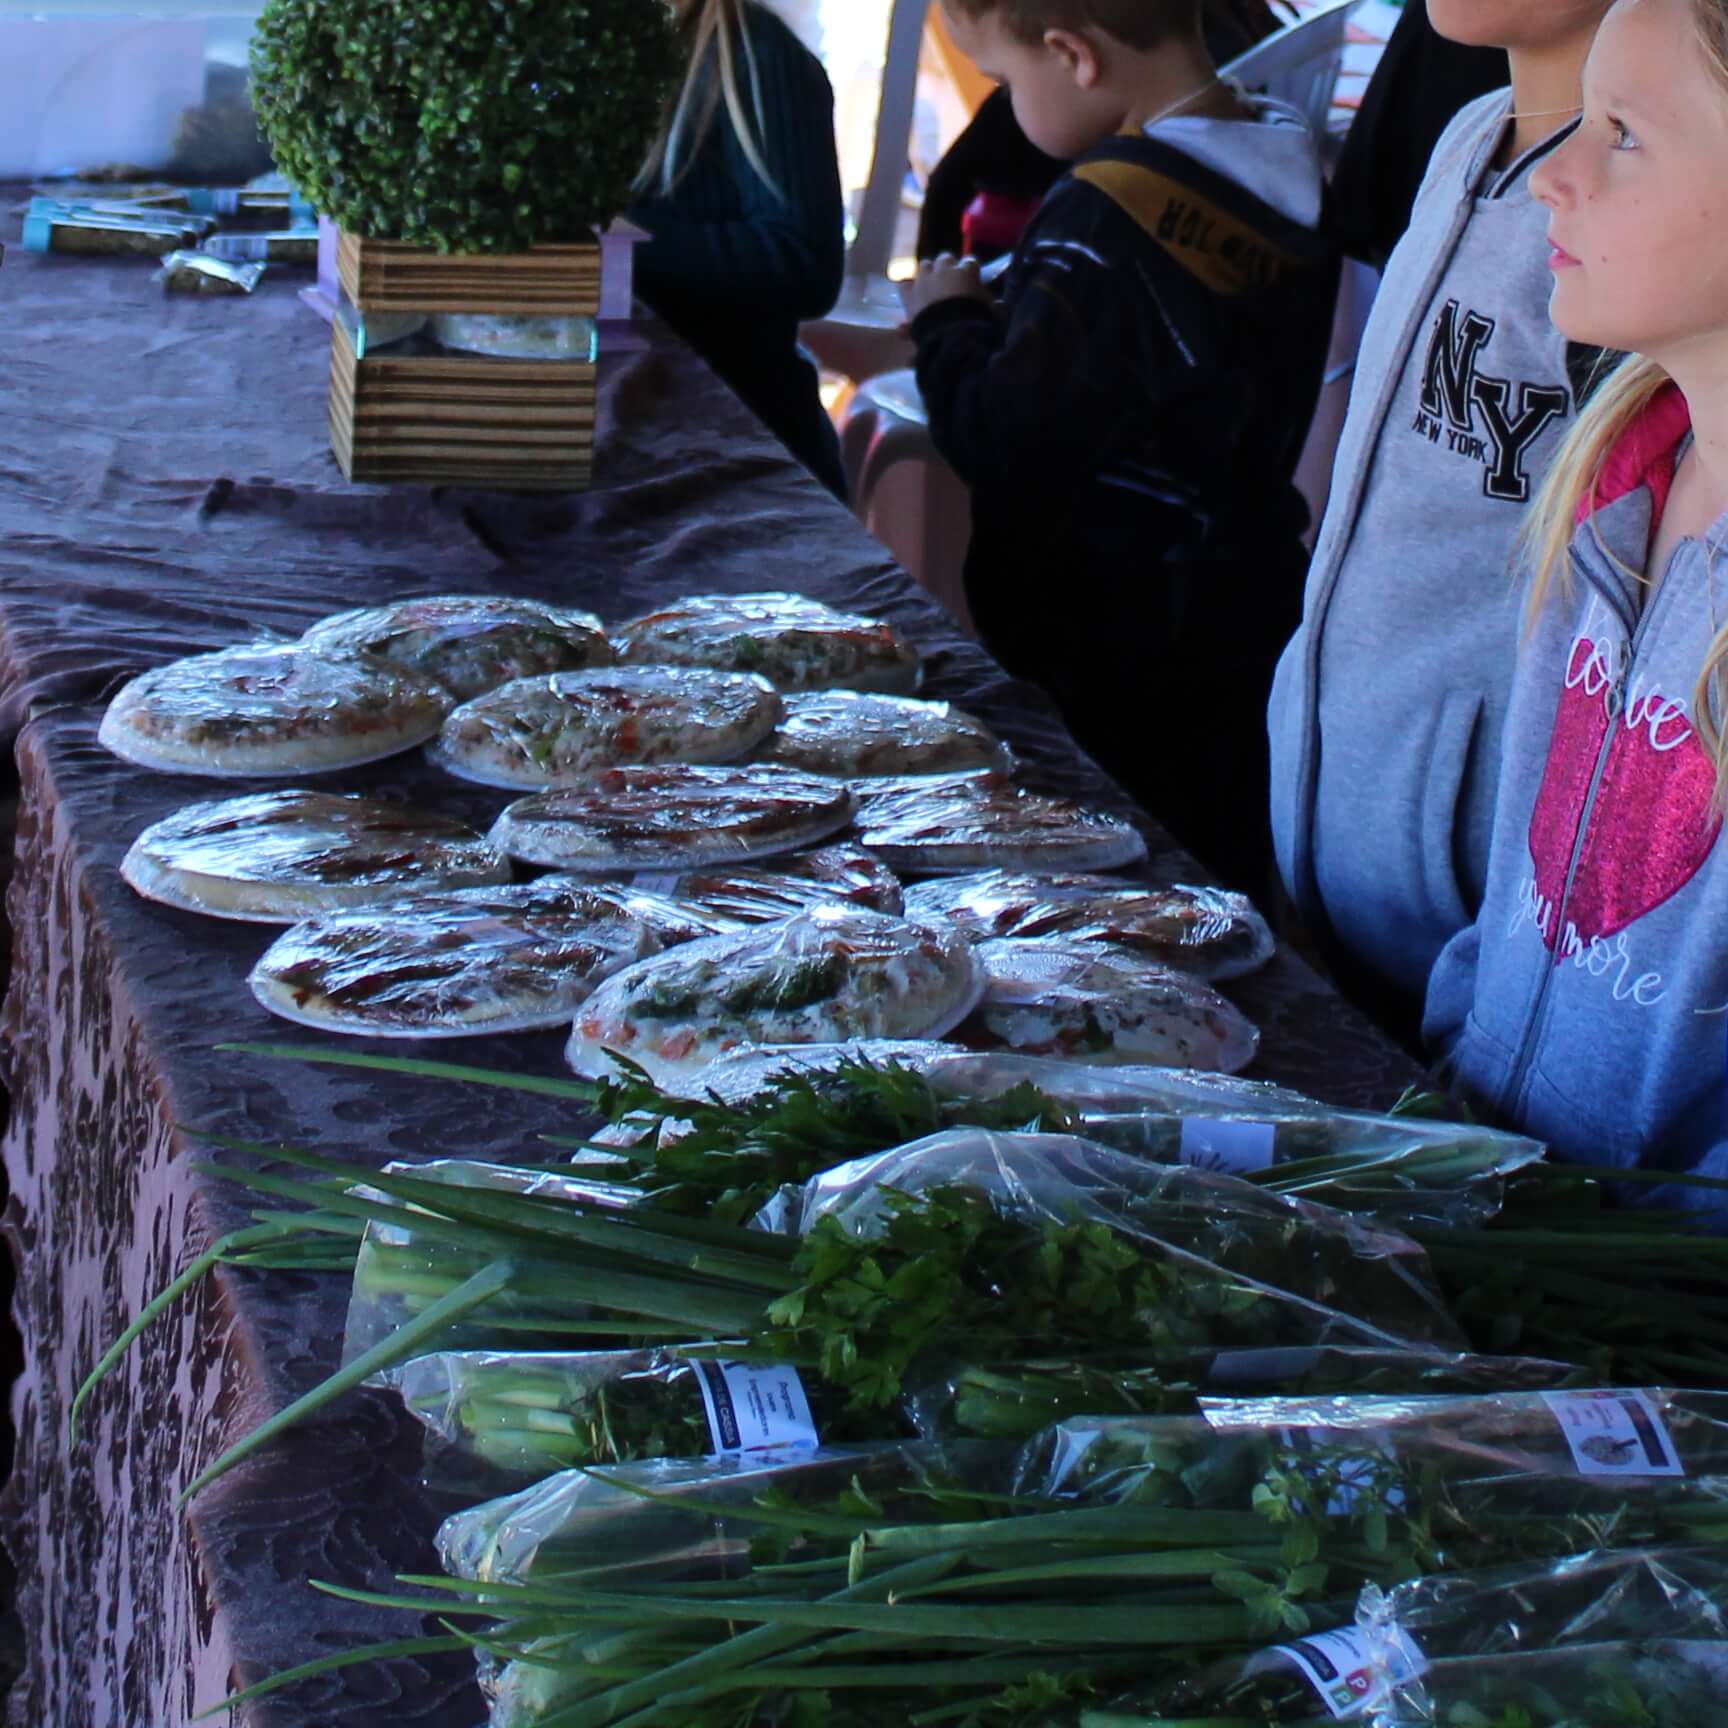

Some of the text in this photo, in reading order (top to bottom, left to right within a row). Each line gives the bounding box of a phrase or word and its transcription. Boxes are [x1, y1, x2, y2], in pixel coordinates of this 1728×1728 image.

[1411, 410, 1488, 464] NEW YORK
[1420, 298, 1570, 503] NY
[1560, 921, 1667, 1006] more
